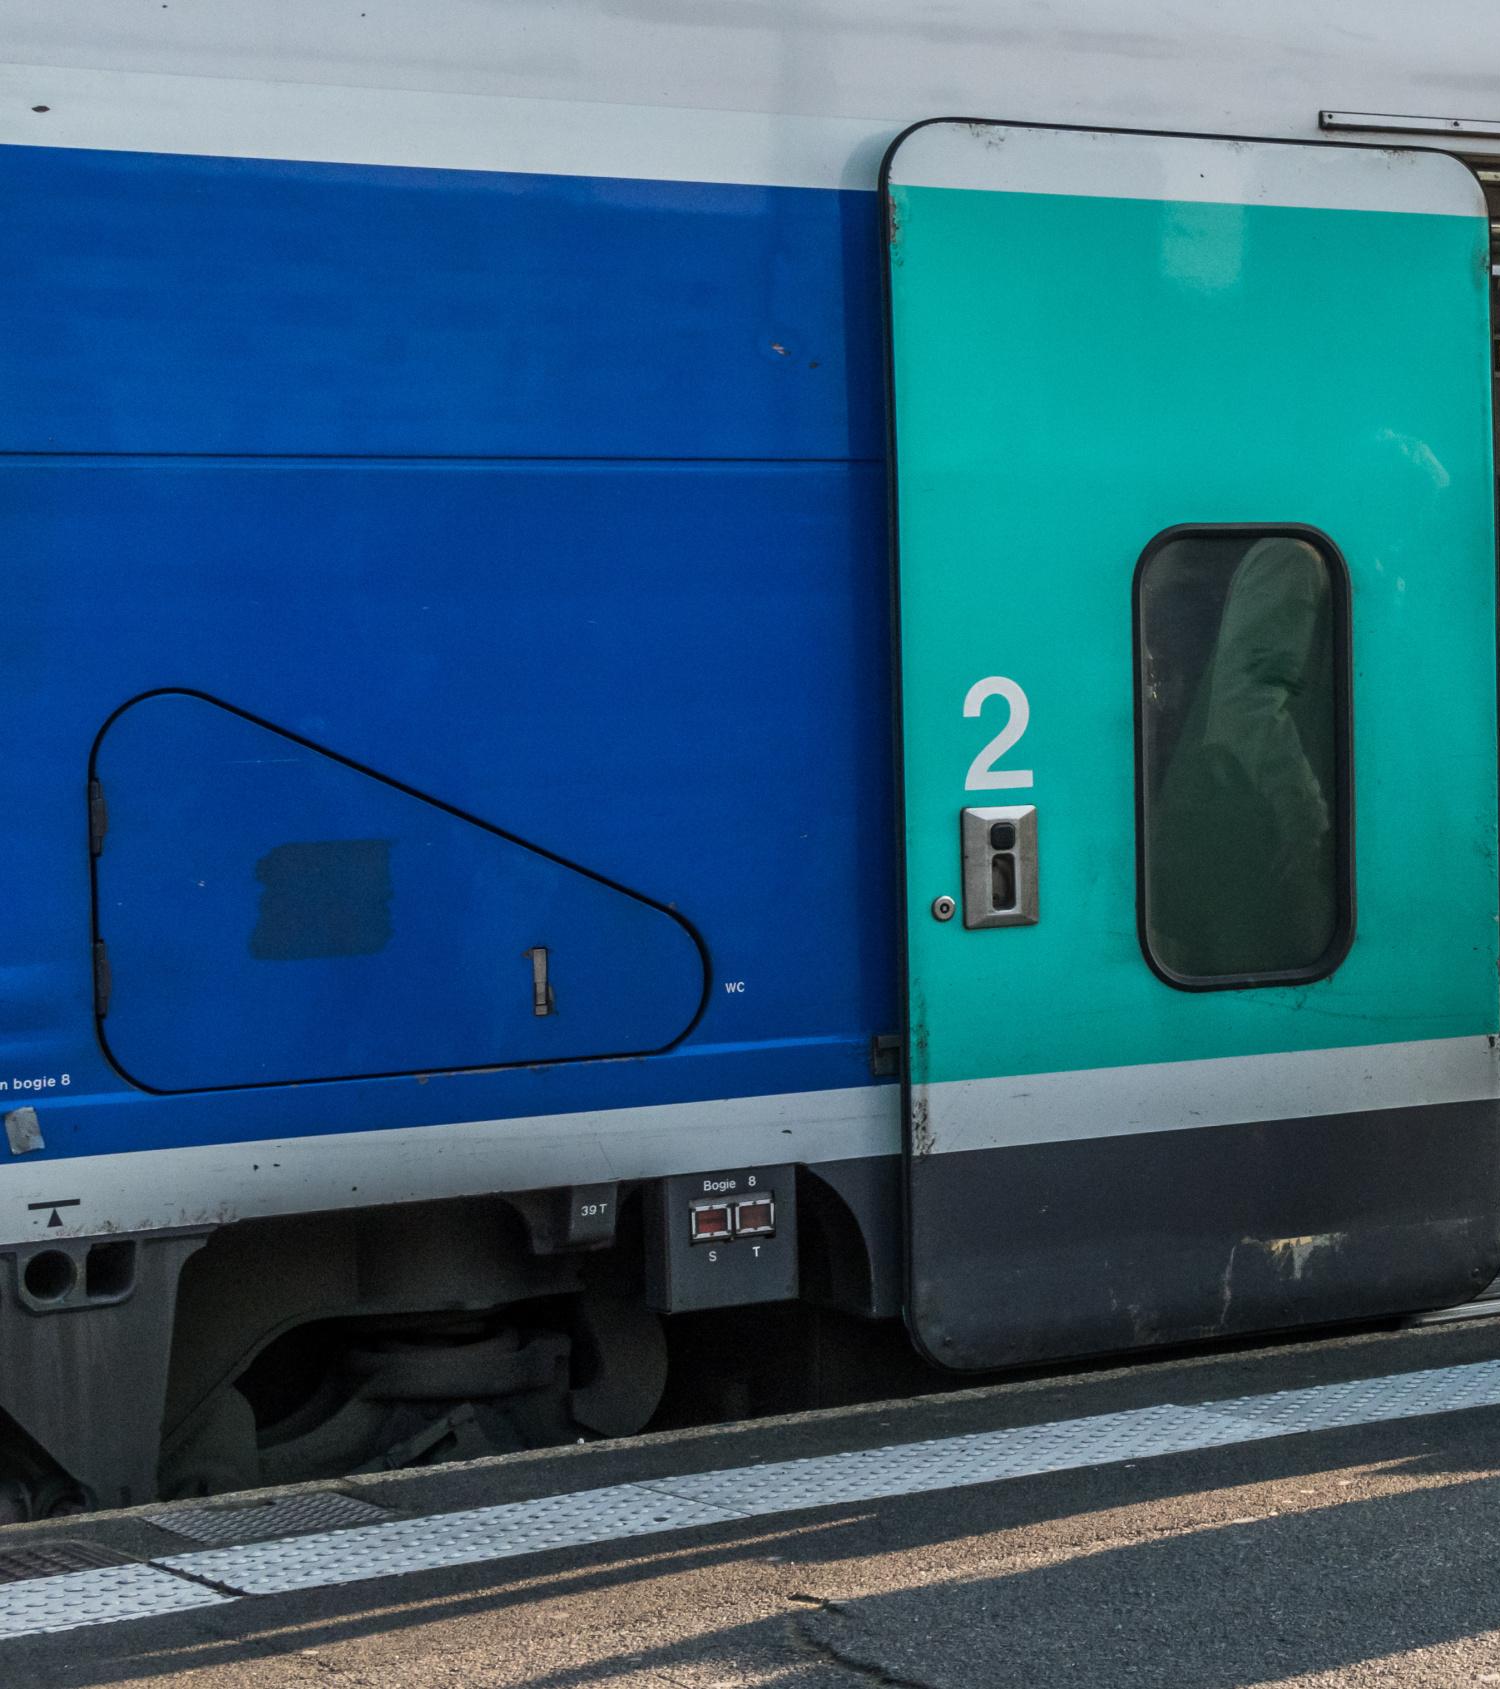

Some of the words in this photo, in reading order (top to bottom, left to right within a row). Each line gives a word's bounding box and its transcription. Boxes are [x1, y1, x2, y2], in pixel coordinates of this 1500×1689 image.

[963, 676, 1034, 790] 2
[725, 981, 745, 993] WC
[13, 1076, 56, 1091] bogie
[61, 1073, 71, 1086] 8
[703, 1179, 736, 1192] Bogie
[748, 1175, 757, 1187] 8
[708, 1250, 717, 1262] S
[752, 1246, 761, 1258] T
